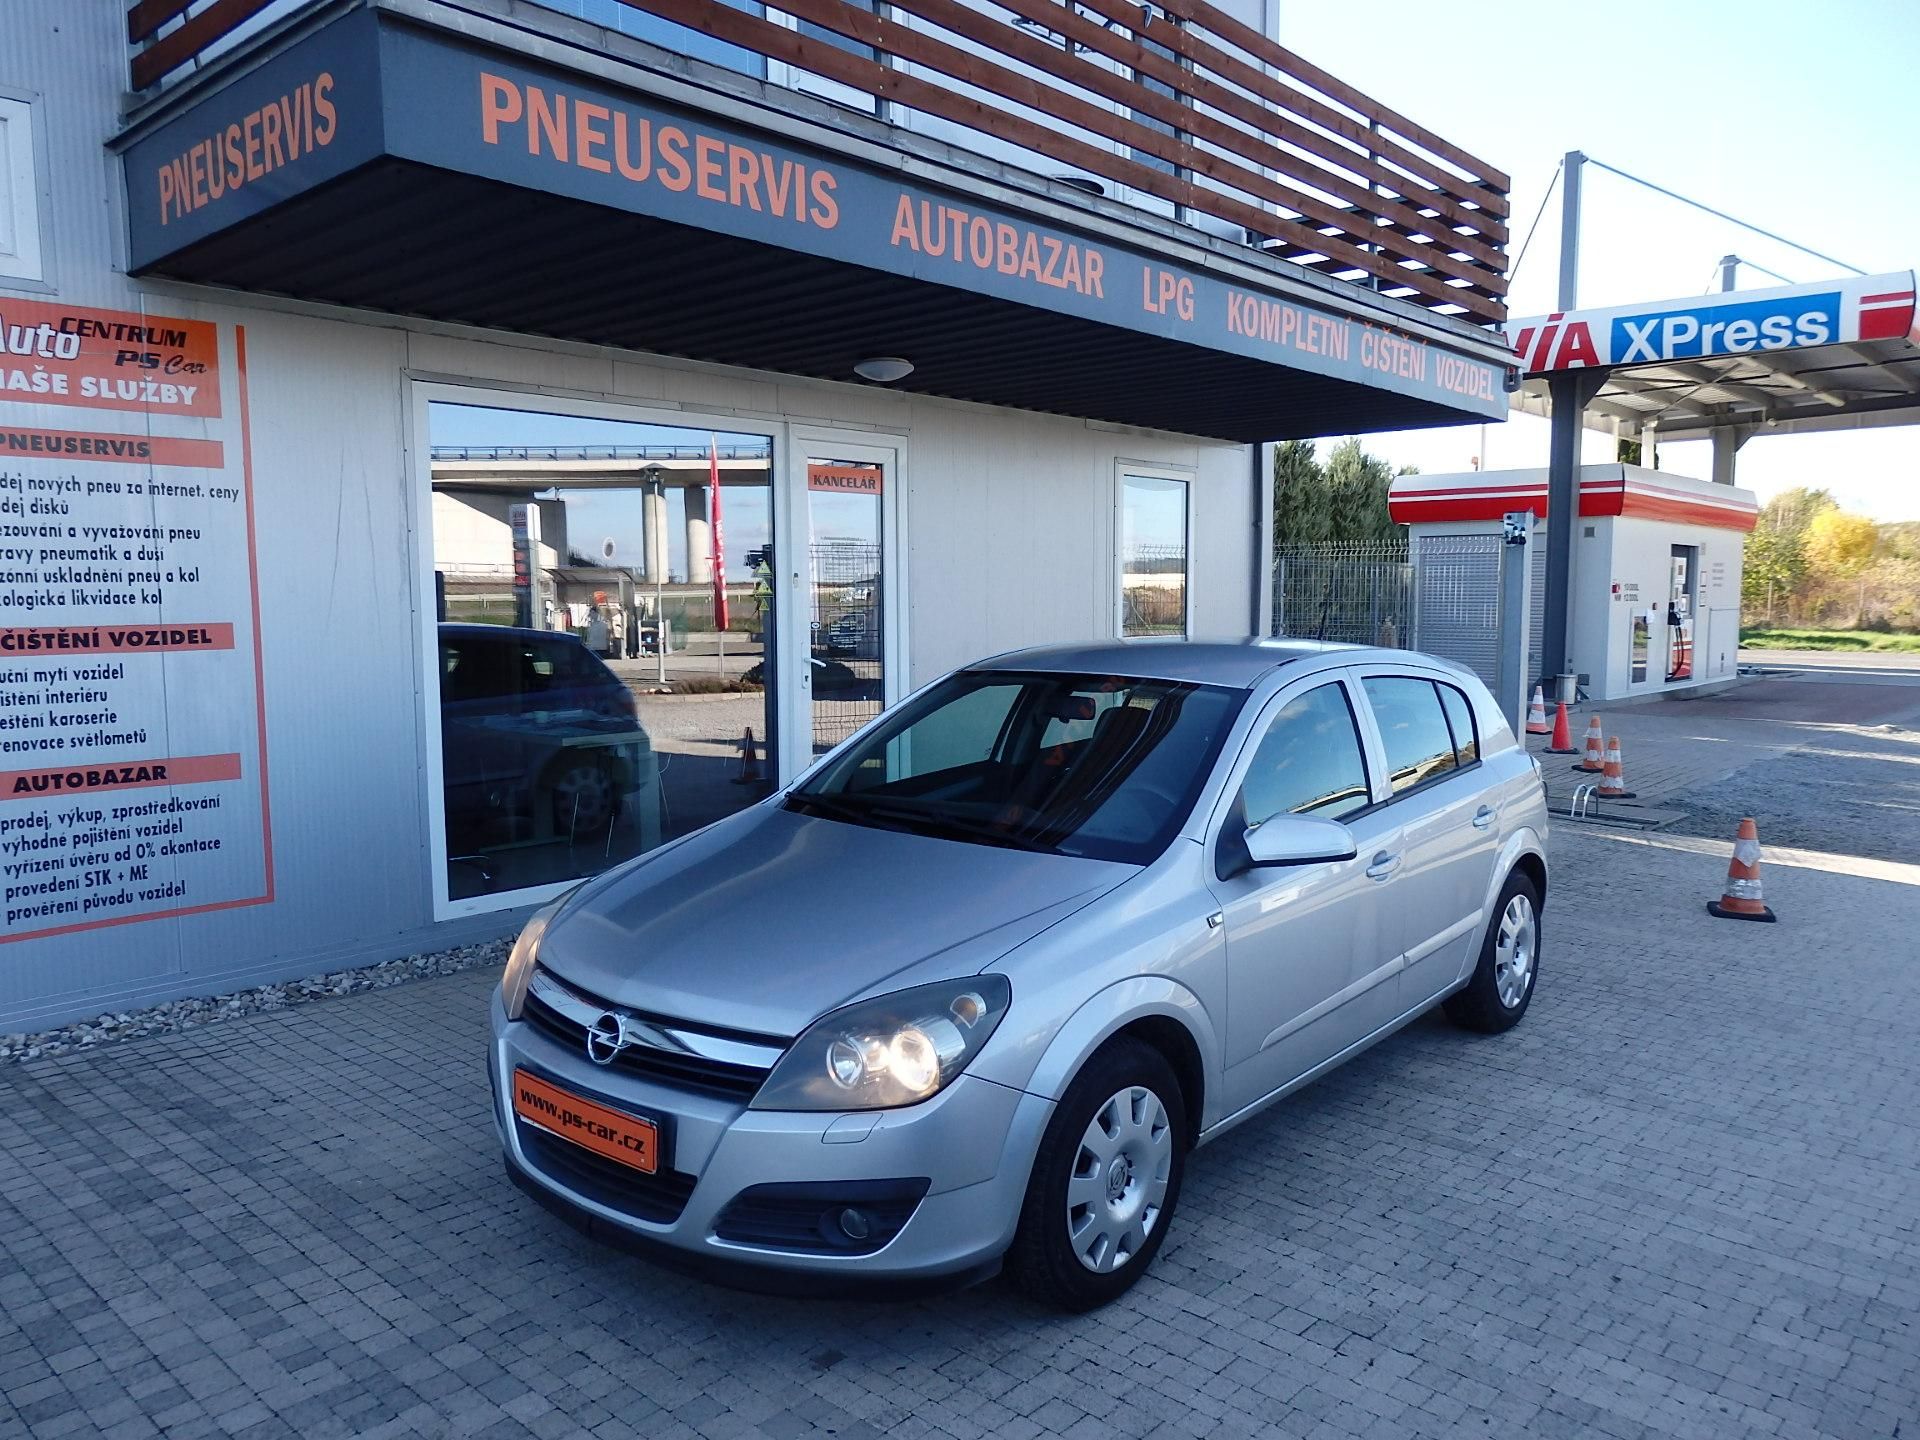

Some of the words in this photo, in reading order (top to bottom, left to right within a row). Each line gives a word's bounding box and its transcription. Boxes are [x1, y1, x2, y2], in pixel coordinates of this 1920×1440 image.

[158, 71, 337, 226] PNEUSERVIS
[479, 70, 840, 230] PNEUSERVIS
[891, 195, 1104, 299] AUTOBAZAR
[1142, 266, 1195, 322] LPG
[1227, 292, 1352, 362] KOMPLETNÍ
[1359, 320, 1428, 382] ČIŠTĚNÍ
[1435, 353, 1495, 402] VOZIDEL
[60, 317, 187, 348] CENTRUM
[1621, 310, 1830, 365] XPress
[115, 350, 161, 369] PS
[80, 375, 198, 406] SLUŽBY
[28, 476, 81, 495] nových
[87, 481, 121, 496] pneu
[127, 483, 143, 494] za
[209, 487, 239, 502] ceny
[813, 474, 876, 490] KANCELÁŘ
[30, 497, 69, 514] disků
[0, 522, 62, 537] zouvání
[68, 527, 76, 537] a
[83, 525, 163, 542] vyvažování
[169, 529, 200, 543] pneu
[40, 545, 117, 564] pneumatik
[124, 550, 131, 560] a
[138, 545, 164, 561] duší
[44, 566, 122, 583] uskladnění
[128, 572, 161, 586] pneu
[166, 572, 174, 583] a
[179, 567, 199, 582] kol
[72, 589, 136, 606] likvidace
[141, 588, 161, 604] kol
[1, 627, 100, 650] ČIŠTĚNÍ
[108, 629, 212, 647] VOZIDEL
[34, 667, 68, 686] mytí
[73, 663, 124, 681] vozidel
[46, 687, 108, 704] interiéru
[50, 708, 117, 727] karoserie
[70, 728, 147, 748] světlometů
[13, 765, 168, 794] AUTOBAZAR
[1, 810, 52, 835] prodej,
[58, 807, 107, 828] výkup,
[112, 794, 220, 821] zprostředkování
[2, 833, 67, 857] výhodné
[73, 825, 131, 847] pojištění
[135, 817, 183, 837] vozidel
[4, 857, 65, 879] vyřízení
[70, 852, 110, 868] úvěru
[114, 847, 131, 862] od
[136, 842, 156, 858] 0%
[161, 838, 221, 856] akontace
[5, 875, 79, 902] provedení
[84, 869, 112, 887] STK
[130, 865, 149, 881] ME
[7, 898, 78, 925] prověření
[83, 888, 134, 913] původu
[138, 880, 186, 901] vozidel
[521, 1088, 645, 1154] www.ps-car.cz
